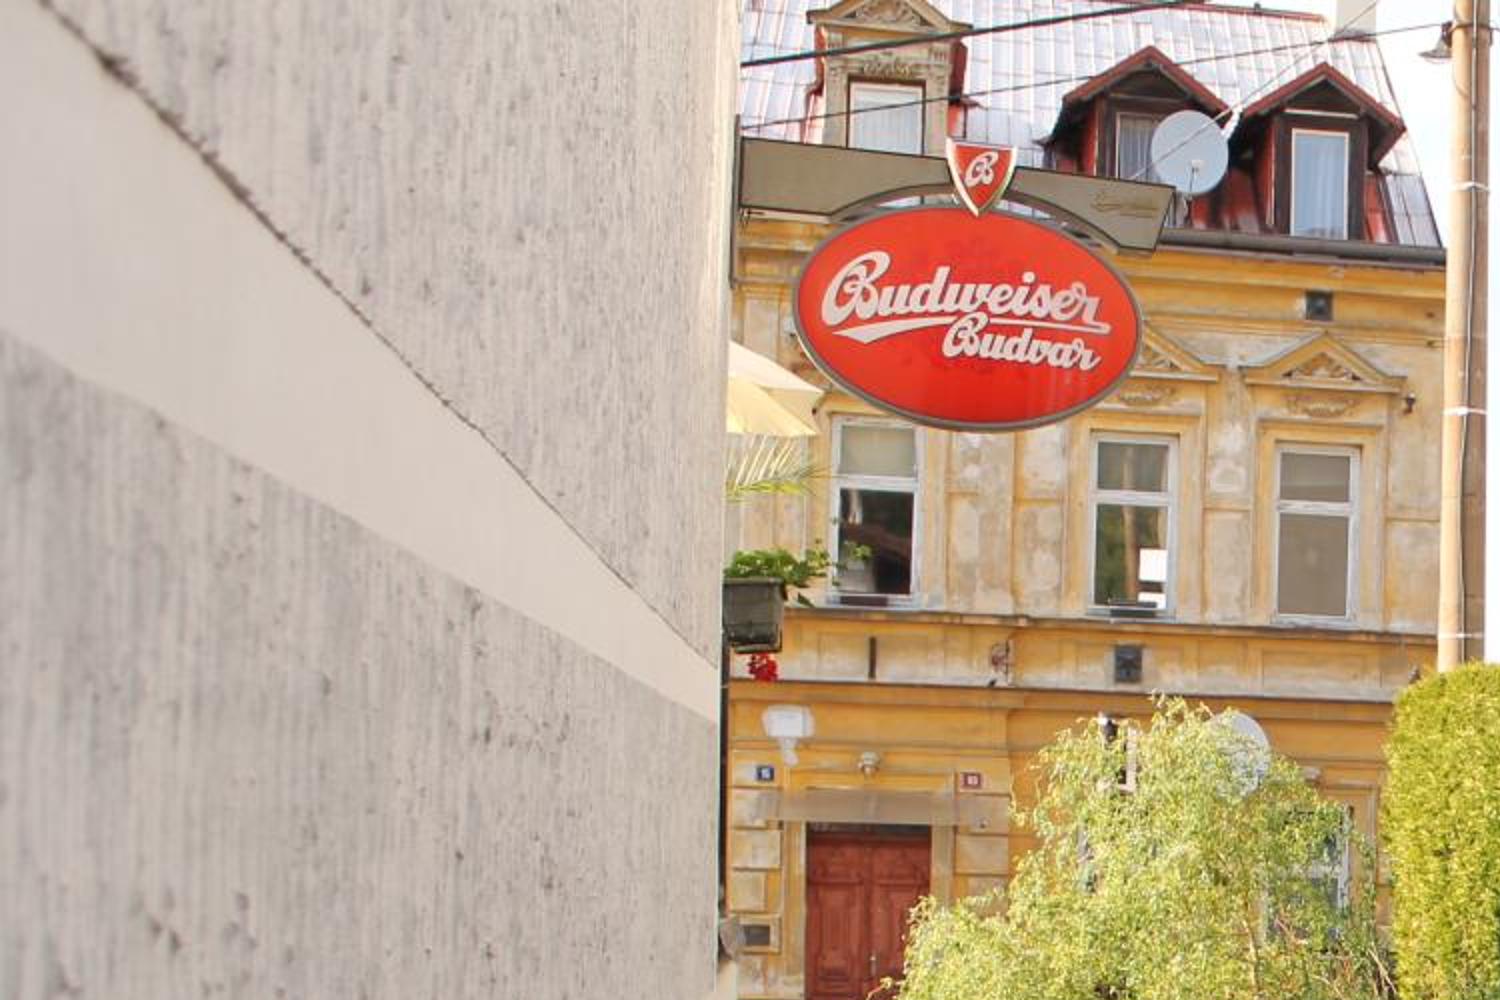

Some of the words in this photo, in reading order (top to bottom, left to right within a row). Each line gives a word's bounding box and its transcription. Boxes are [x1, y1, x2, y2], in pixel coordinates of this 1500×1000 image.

[964, 151, 999, 187] B
[822, 250, 1110, 334] Budweiser
[942, 311, 1101, 371] Budvar
